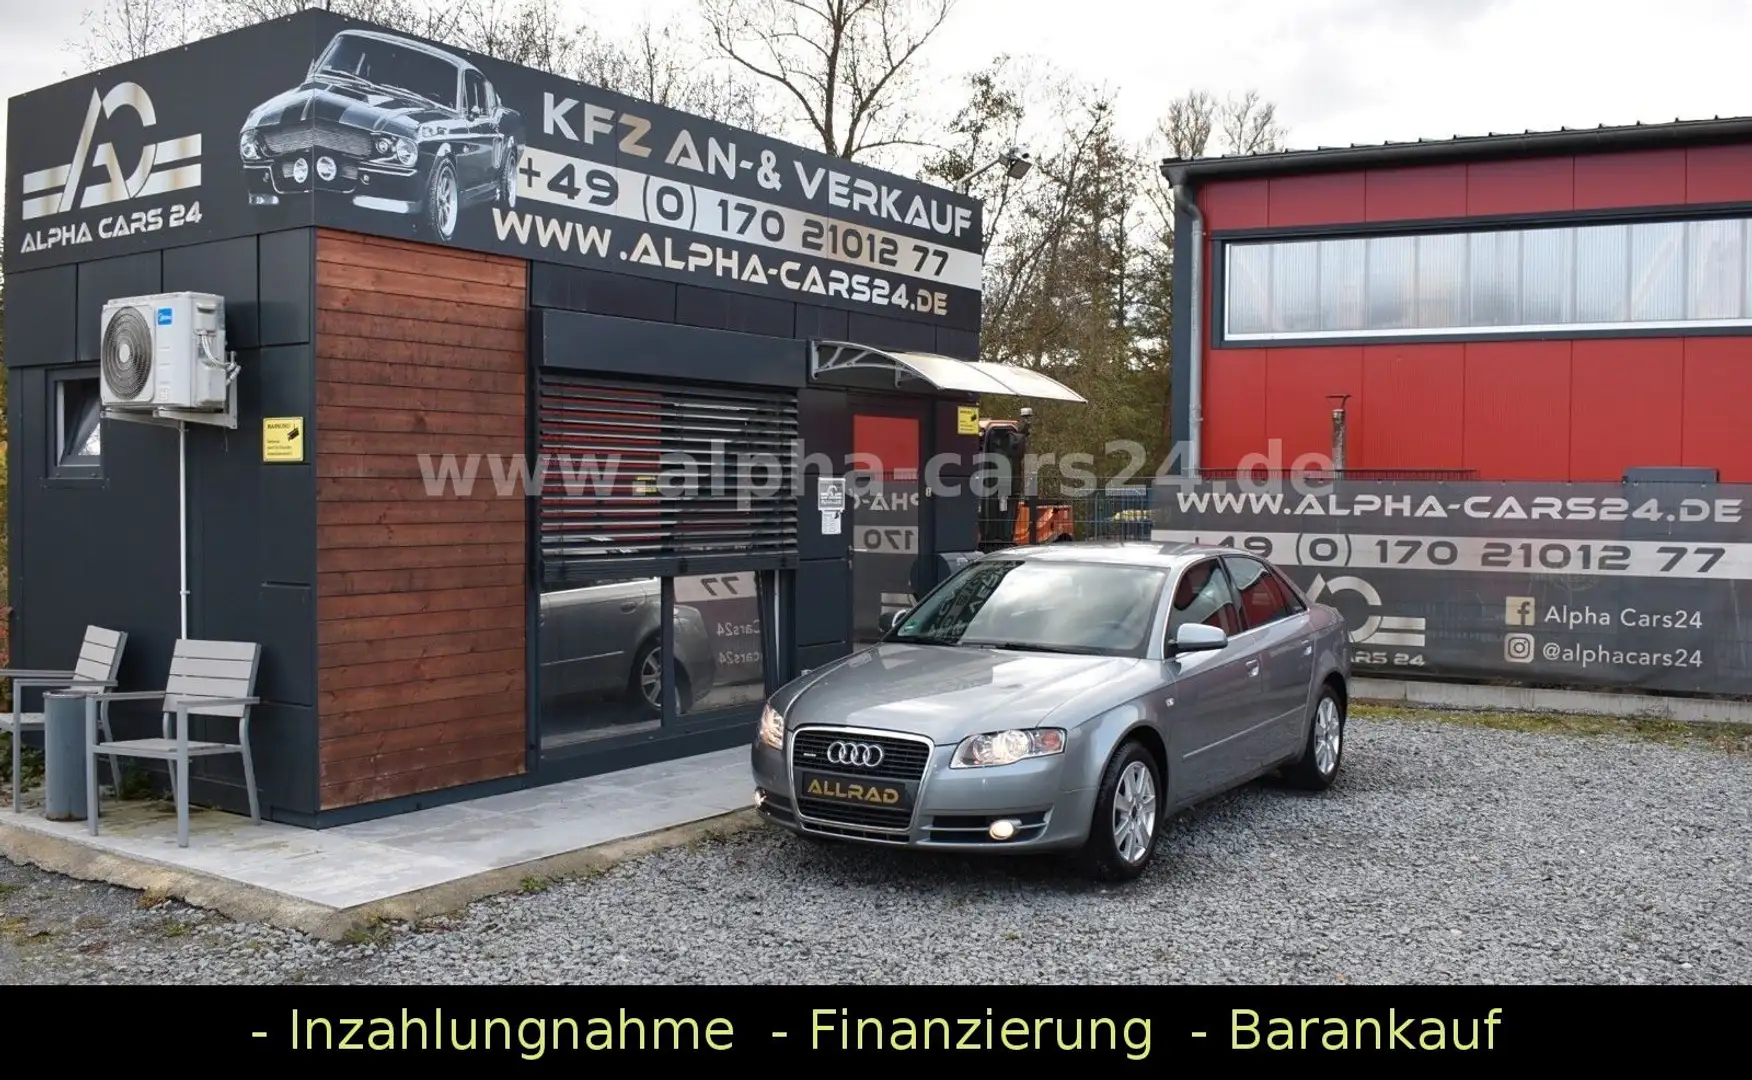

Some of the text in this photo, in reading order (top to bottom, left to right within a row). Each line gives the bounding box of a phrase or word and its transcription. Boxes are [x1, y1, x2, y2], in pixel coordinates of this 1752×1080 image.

[543, 92, 652, 158] KFZ
[794, 160, 973, 237] VERKAUF
[21, 200, 203, 254] ALPHA CARS 24
[519, 156, 950, 277] +49 (0) 170 21012 77
[1176, 492, 1743, 524] WWW.ALPHA-CARS24.DE
[1296, 532, 1352, 567] (0)
[1374, 538, 1459, 566] 170
[1480, 541, 1632, 571] 21012
[1656, 546, 1727, 574] 77
[1544, 605, 1611, 630] Alpha
[1620, 608, 1703, 629] Cars24
[1394, 652, 1427, 667] 24
[1542, 642, 1703, 669] @alphacars24
[807, 778, 900, 804] ALLRAD
